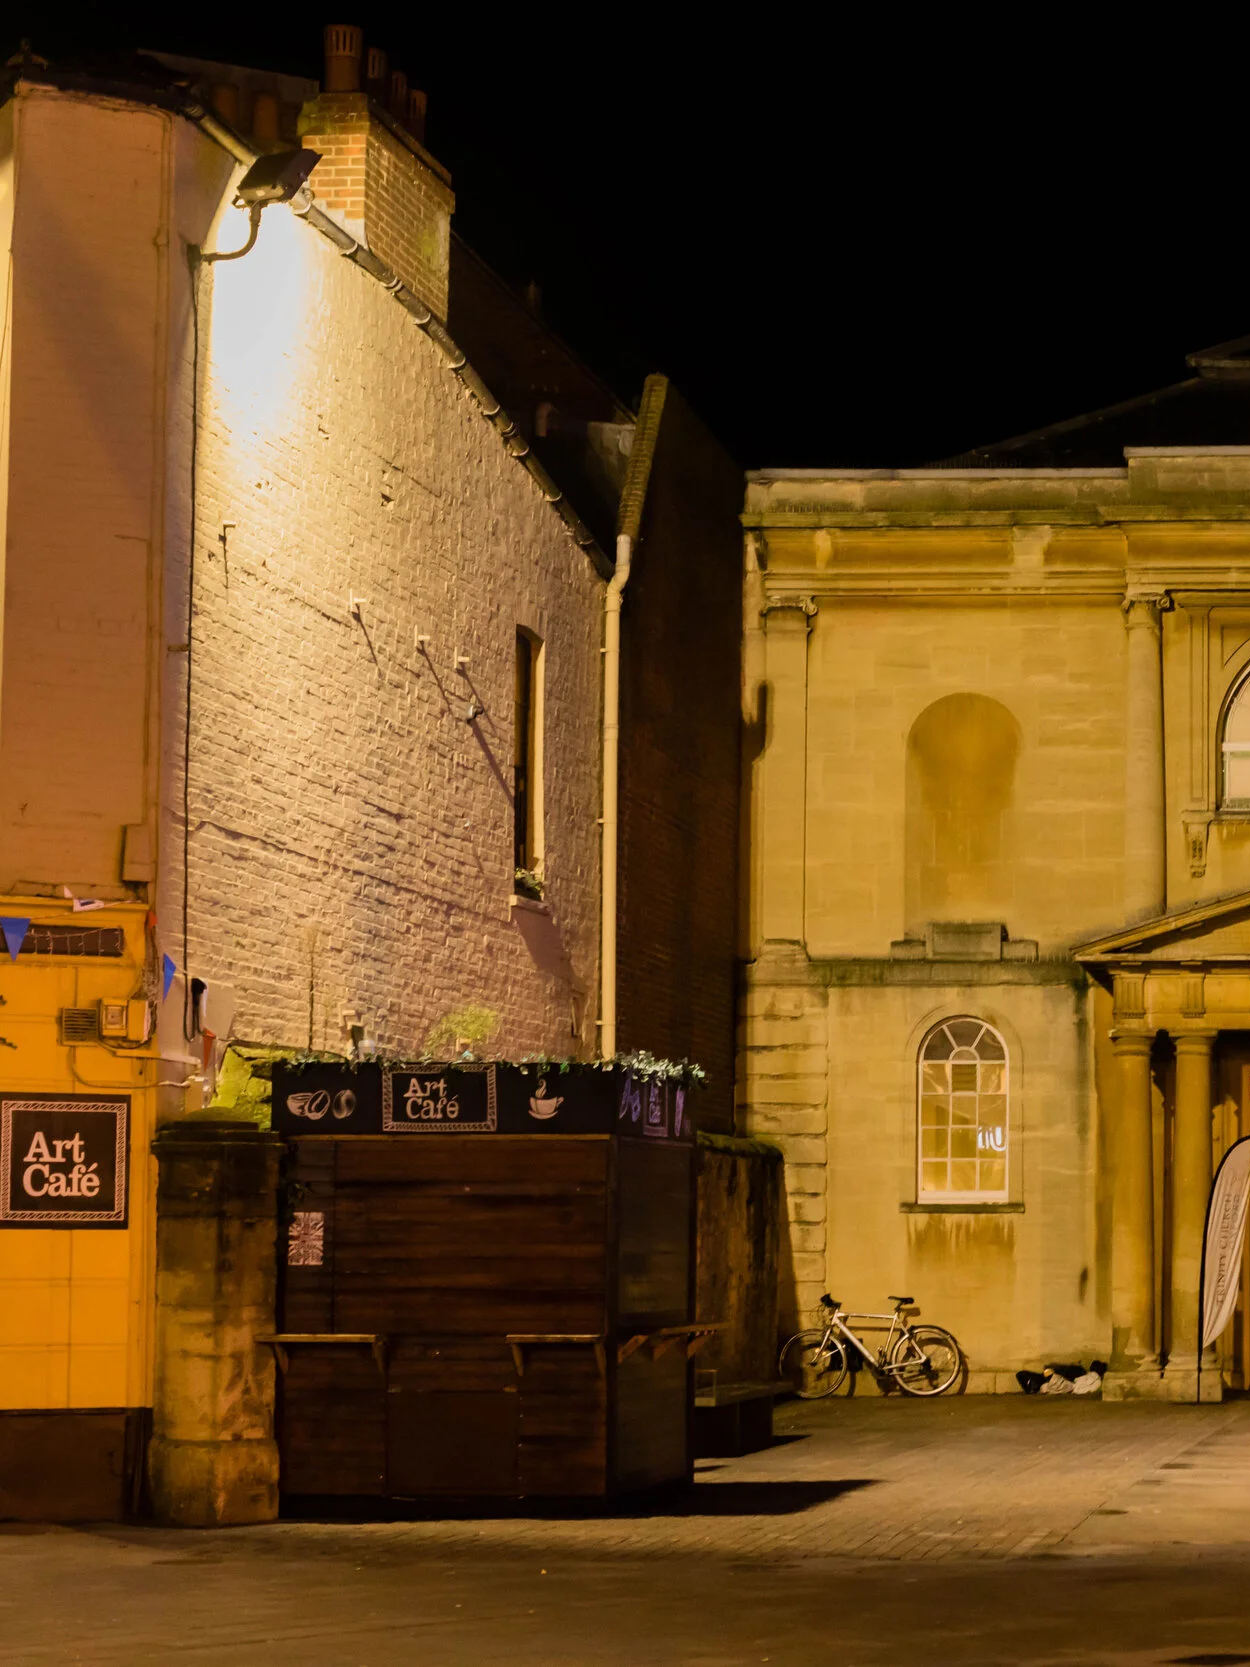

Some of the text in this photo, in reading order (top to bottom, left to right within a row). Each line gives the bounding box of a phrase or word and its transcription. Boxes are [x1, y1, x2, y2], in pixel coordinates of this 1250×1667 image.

[403, 1077, 447, 1098] Art
[405, 1094, 459, 1119] Café
[23, 1131, 85, 1163] Art
[22, 1162, 100, 1197] Café
[1215, 1194, 1232, 1306] TRINITY CHURCH
